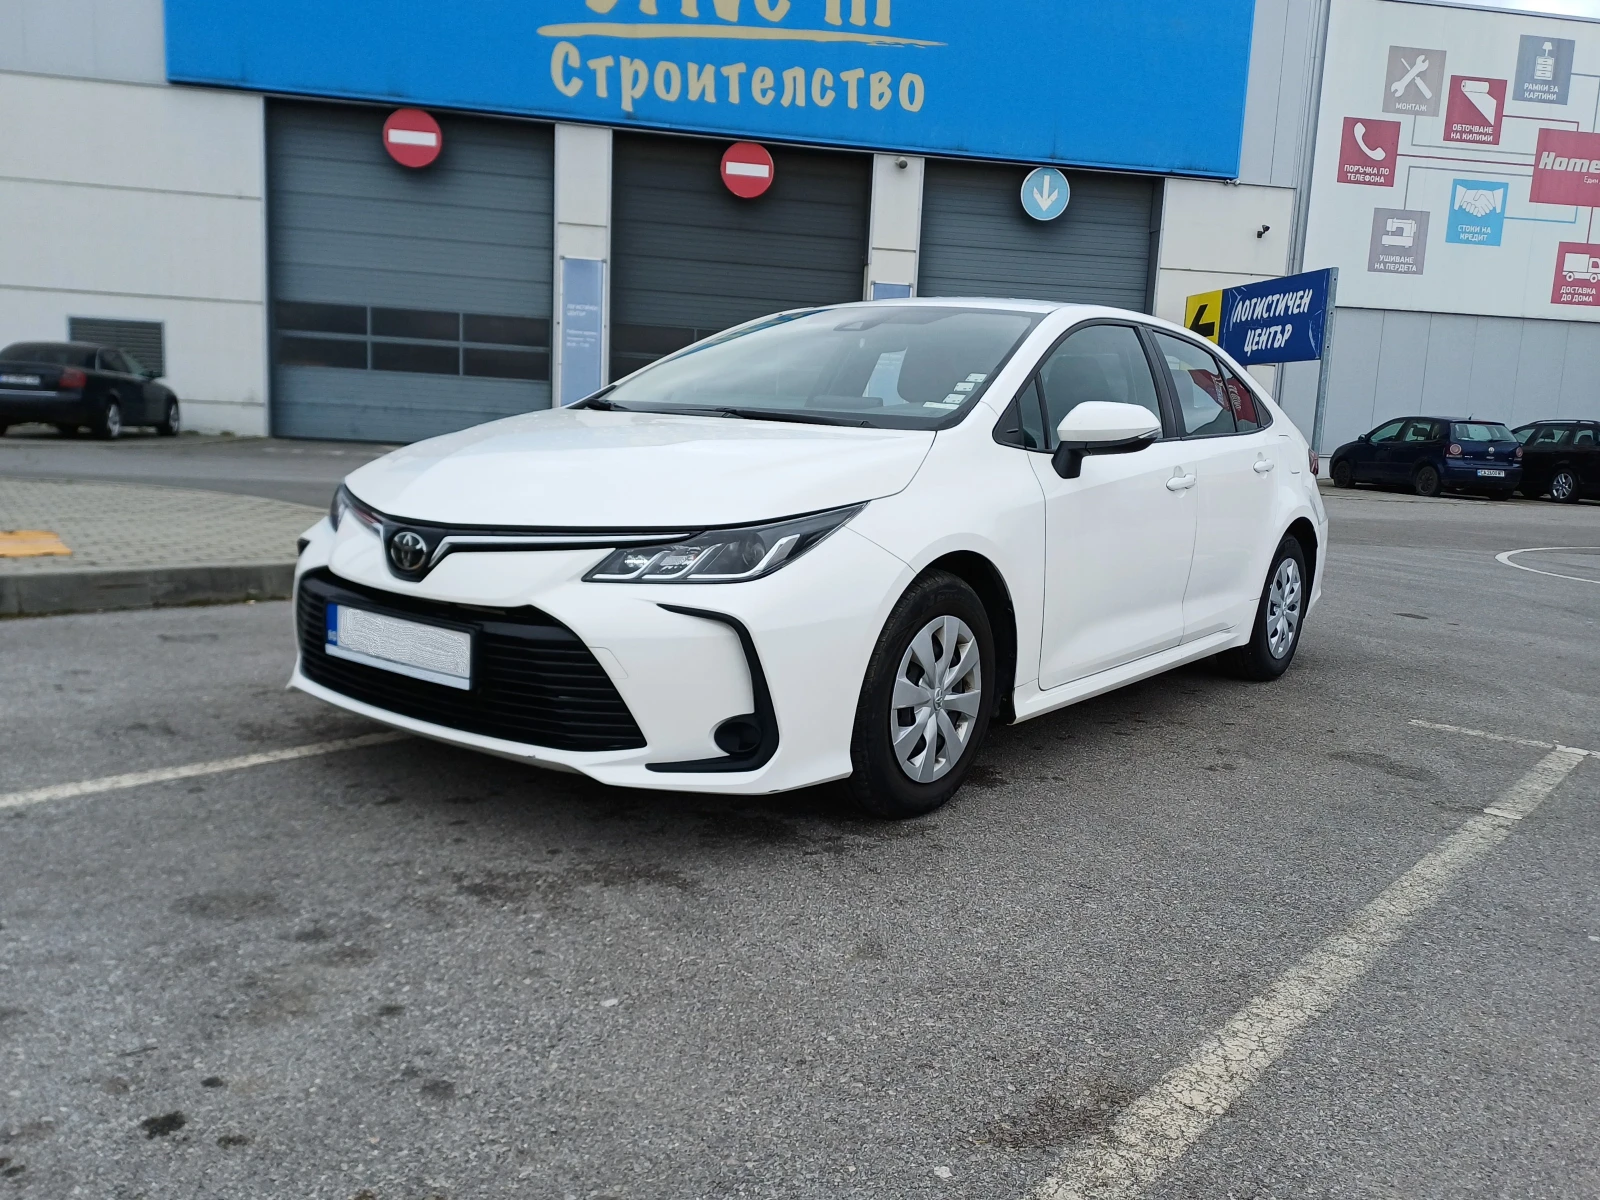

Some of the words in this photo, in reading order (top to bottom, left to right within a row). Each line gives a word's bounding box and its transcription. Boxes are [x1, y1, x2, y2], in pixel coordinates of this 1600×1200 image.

[550, 40, 925, 112] Строителство
[1524, 83, 1548, 92] РАМКИ
[1549, 85, 1559, 93] ЗА
[1524, 91, 1557, 101] КАРТИНИ
[1395, 102, 1427, 112] МОНТАЖ
[1452, 124, 1494, 134] ОБТОЧВАНЕ
[1451, 132, 1461, 140] НА
[1462, 133, 1493, 142] КИЛИМИ
[1538, 151, 1600, 174] Home
[1344, 165, 1378, 175] ПОРЪЧКА
[1347, 173, 1385, 183] ТЕЛЕФОНА
[1458, 225, 1480, 233] СТОКИ
[1482, 226, 1492, 234] НА
[1460, 232, 1487, 241] КРЕДИТ
[1379, 254, 1414, 263] УШИВАНЕ
[1374, 262, 1384, 270] НА
[1386, 263, 1417, 272] ПЕРДЕТА
[1560, 286, 1596, 295] ДОСТАВКА
[1560, 293, 1571, 302] ДО
[1572, 294, 1593, 302] ДОМА
[1232, 289, 1313, 323] ЛОГИСТИЧЕН
[1244, 323, 1292, 357] ЦЕНТЪР
